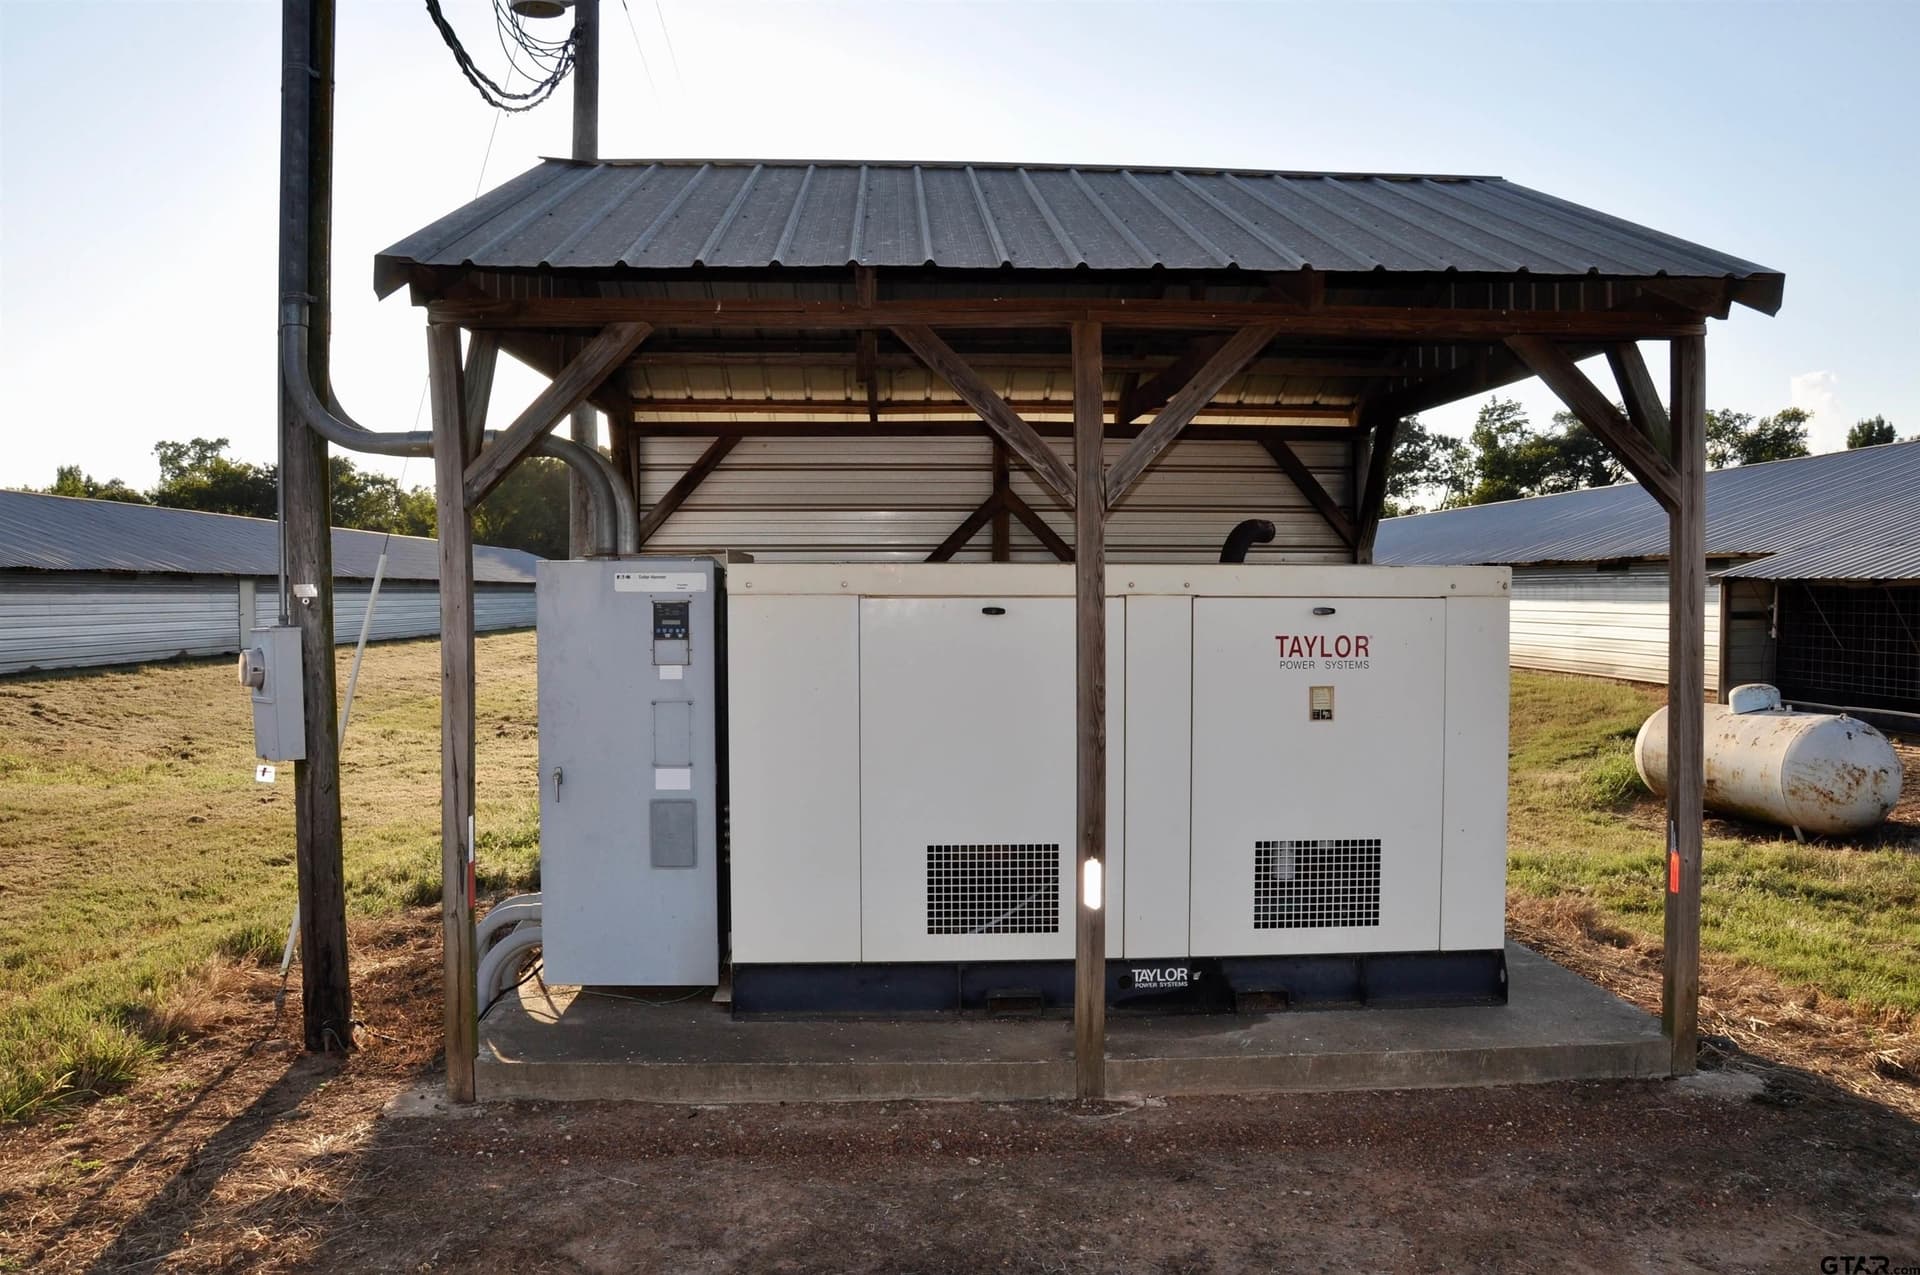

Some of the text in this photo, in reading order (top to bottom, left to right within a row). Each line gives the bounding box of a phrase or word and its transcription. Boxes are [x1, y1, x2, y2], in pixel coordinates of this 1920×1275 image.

[1275, 635, 1369, 658] TAYLOR
[1279, 660, 1370, 670] POWER SYSTEMS
[1131, 968, 1188, 982] TAYLOR
